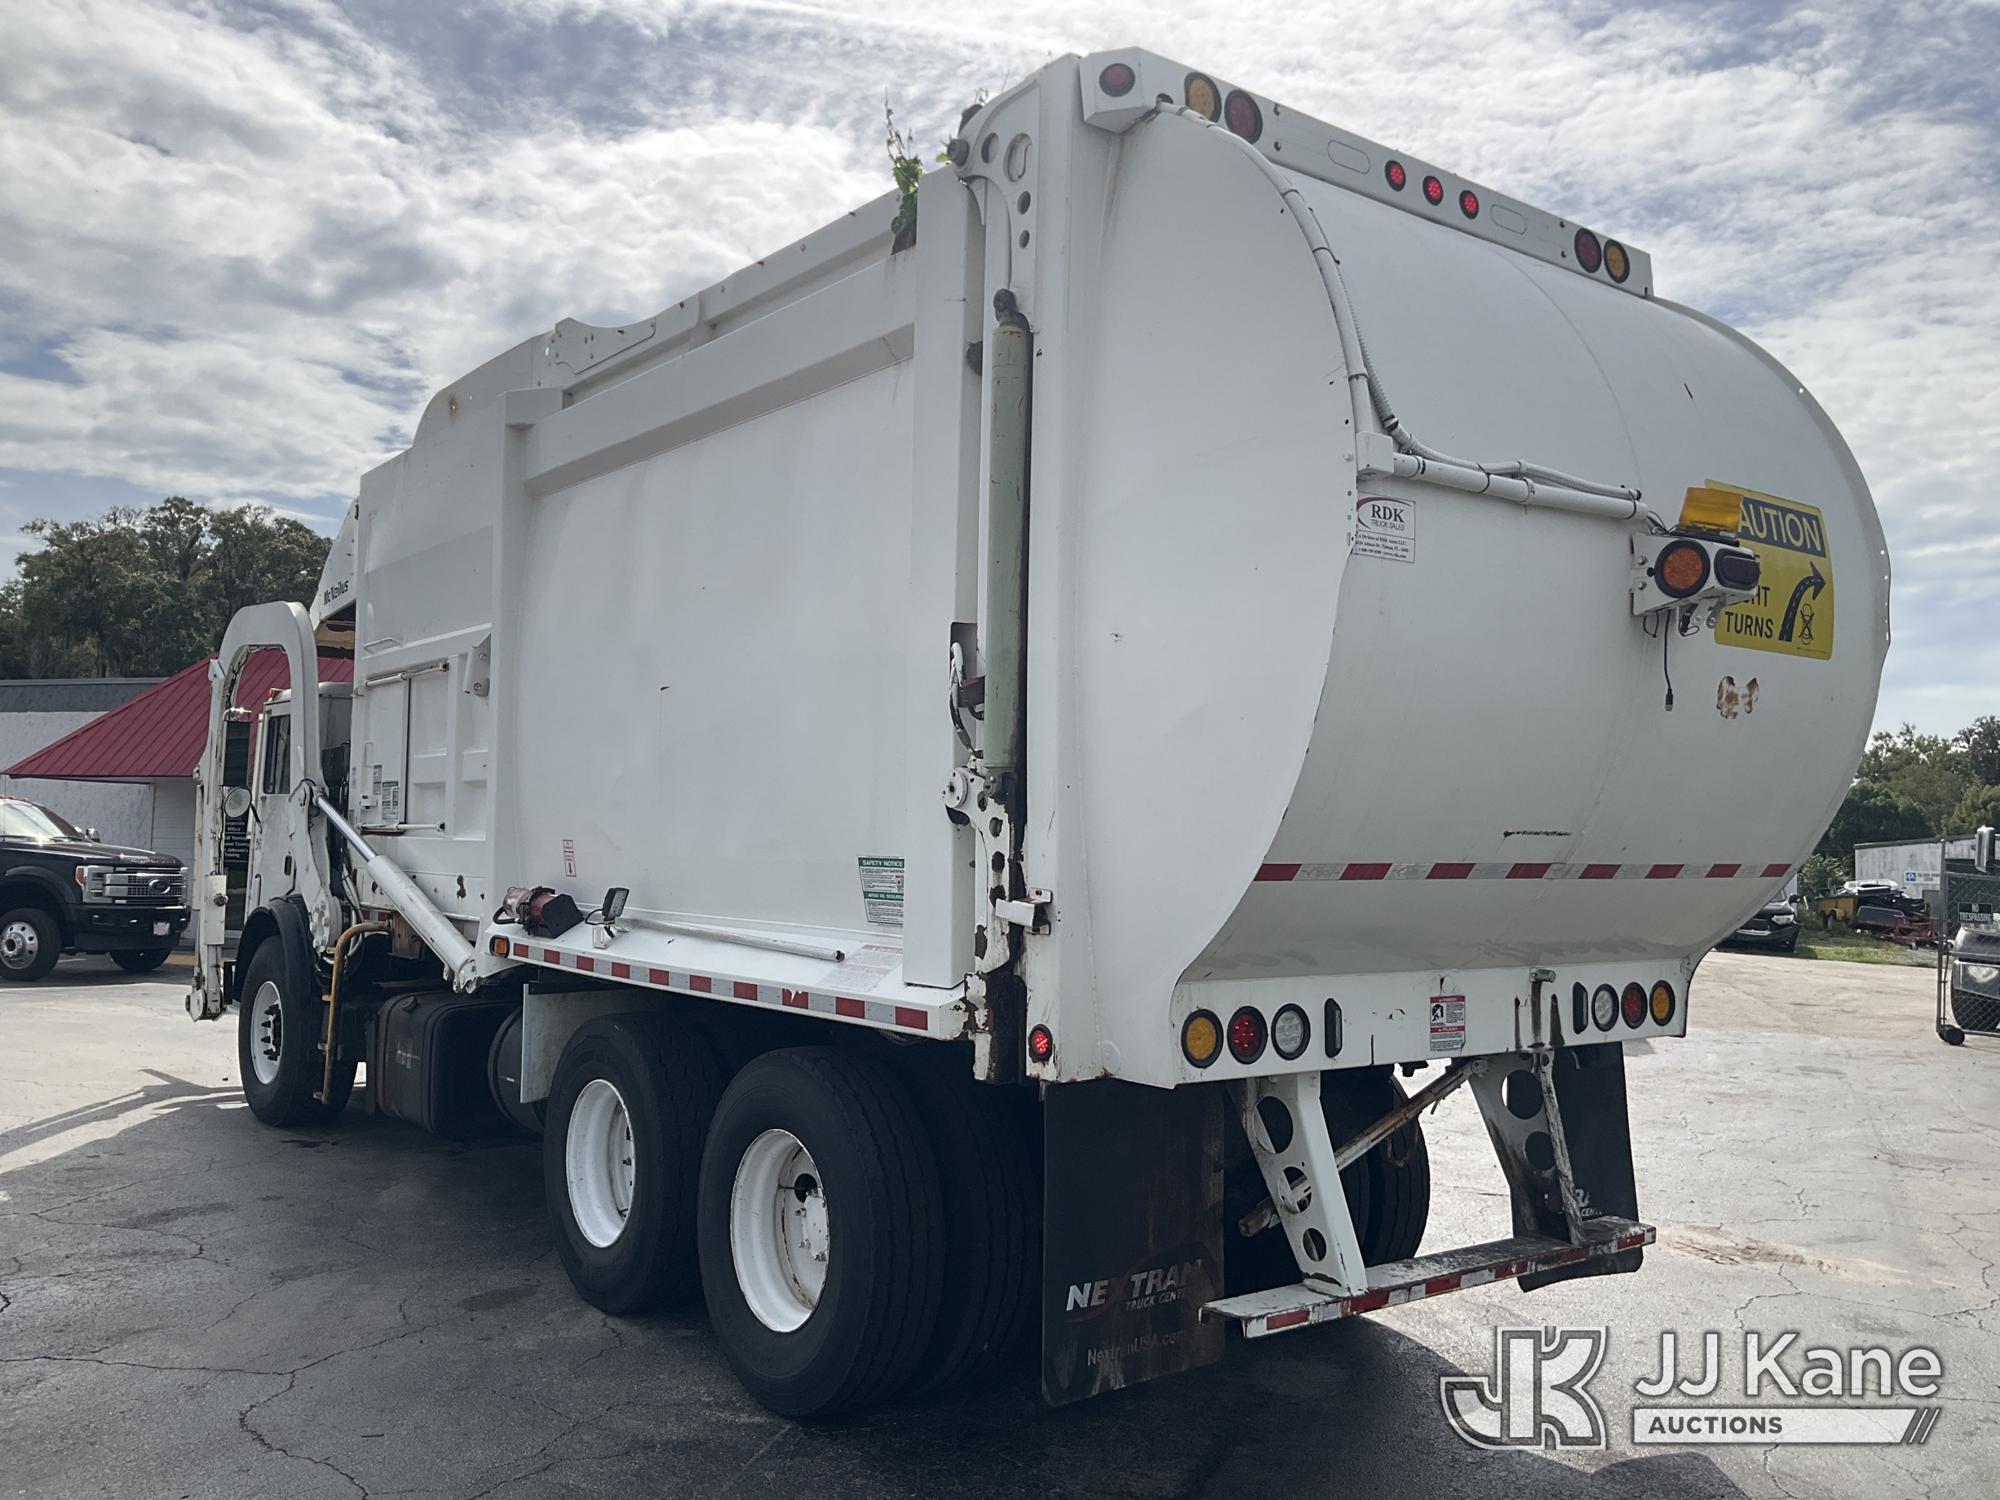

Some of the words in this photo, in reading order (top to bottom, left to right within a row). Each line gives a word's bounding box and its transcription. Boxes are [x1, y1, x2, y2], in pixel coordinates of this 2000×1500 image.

[1371, 504, 1405, 523] RDK
[1371, 519, 1388, 528] TRUCK
[1389, 521, 1405, 531] SALES
[1739, 504, 1821, 551] AUTION
[1725, 611, 1774, 639] TURNS
[1126, 1296, 1155, 1311] TRUCK
